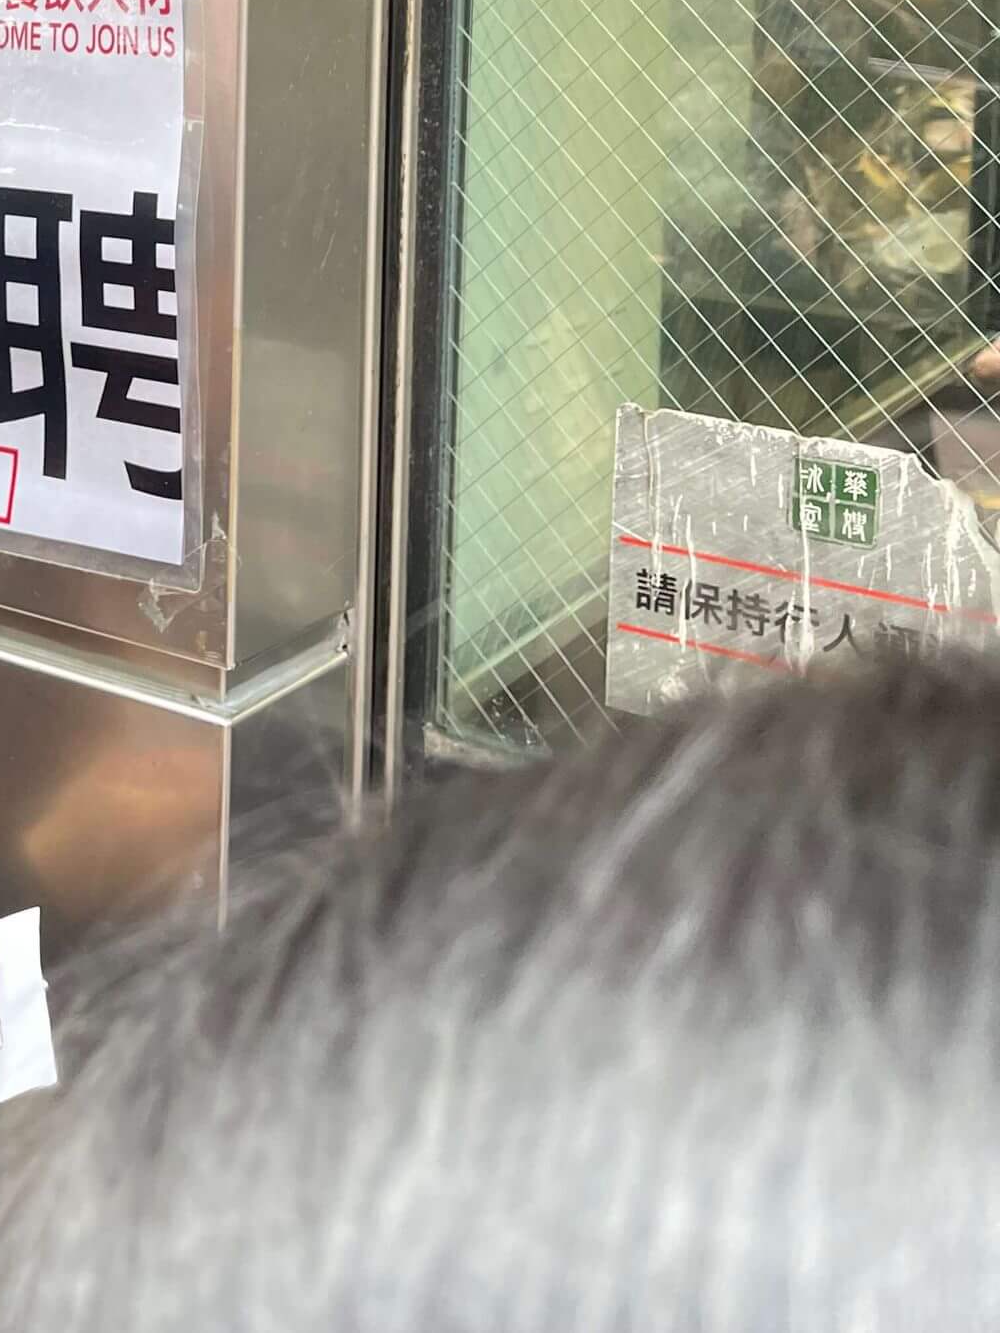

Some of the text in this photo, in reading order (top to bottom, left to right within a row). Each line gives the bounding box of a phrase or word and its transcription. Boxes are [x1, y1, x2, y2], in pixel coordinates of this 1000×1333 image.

[49, 22, 80, 53] TO
[86, 24, 139, 56] JOIN
[147, 25, 176, 57] US
